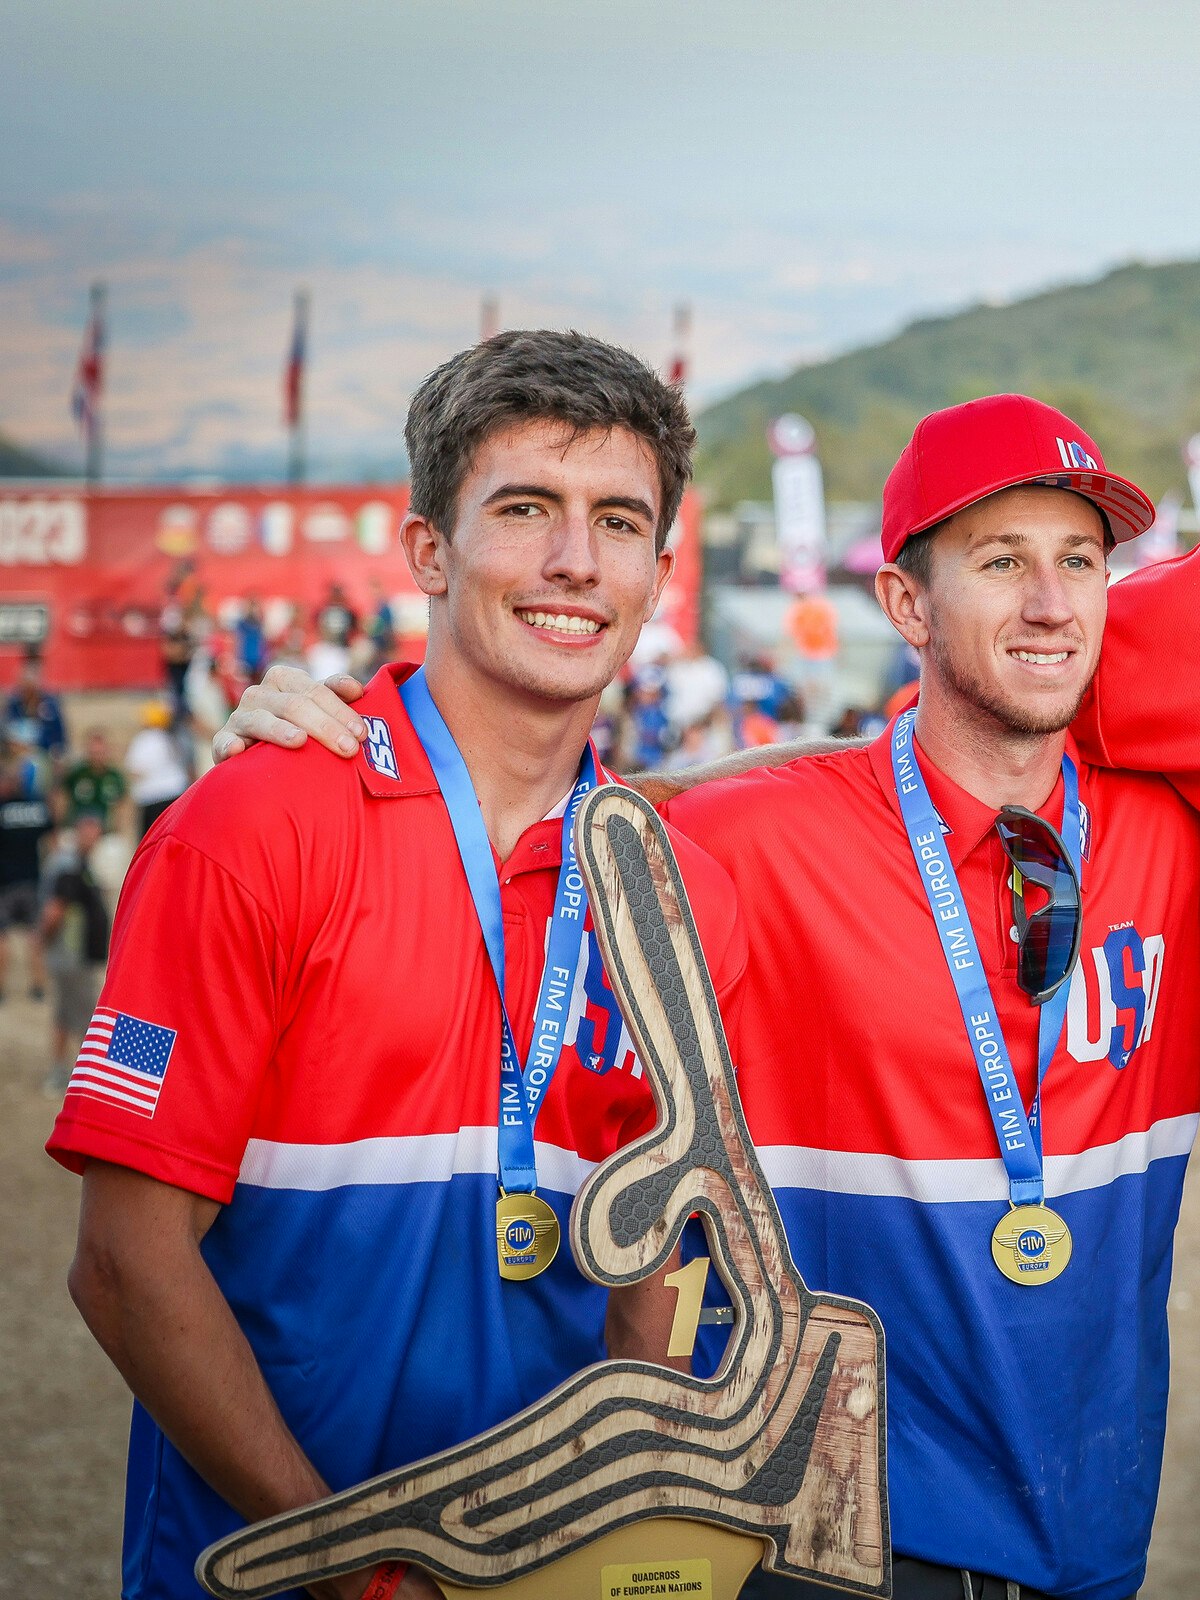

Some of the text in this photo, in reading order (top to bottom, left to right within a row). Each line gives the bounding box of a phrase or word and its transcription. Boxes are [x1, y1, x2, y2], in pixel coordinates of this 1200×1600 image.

[897, 752, 918, 795] FIM
[916, 830, 960, 921] EUROPE
[1108, 920, 1134, 931] TEAM
[946, 927, 974, 970] FIM
[546, 966, 569, 1011] FIM
[1067, 927, 1165, 1071] USA
[970, 1011, 1026, 1151] FIM EUROPE
[502, 1083, 523, 1126] FIM
[508, 1227, 531, 1242] FIM
[1020, 1236, 1043, 1251] FIM
[1022, 1262, 1047, 1270] EUROPE
[664, 1257, 710, 1357] 1
[611, 1582, 702, 1597] OF EUROPEAN NATIONS
[632, 1570, 680, 1583] QUADCROSS
